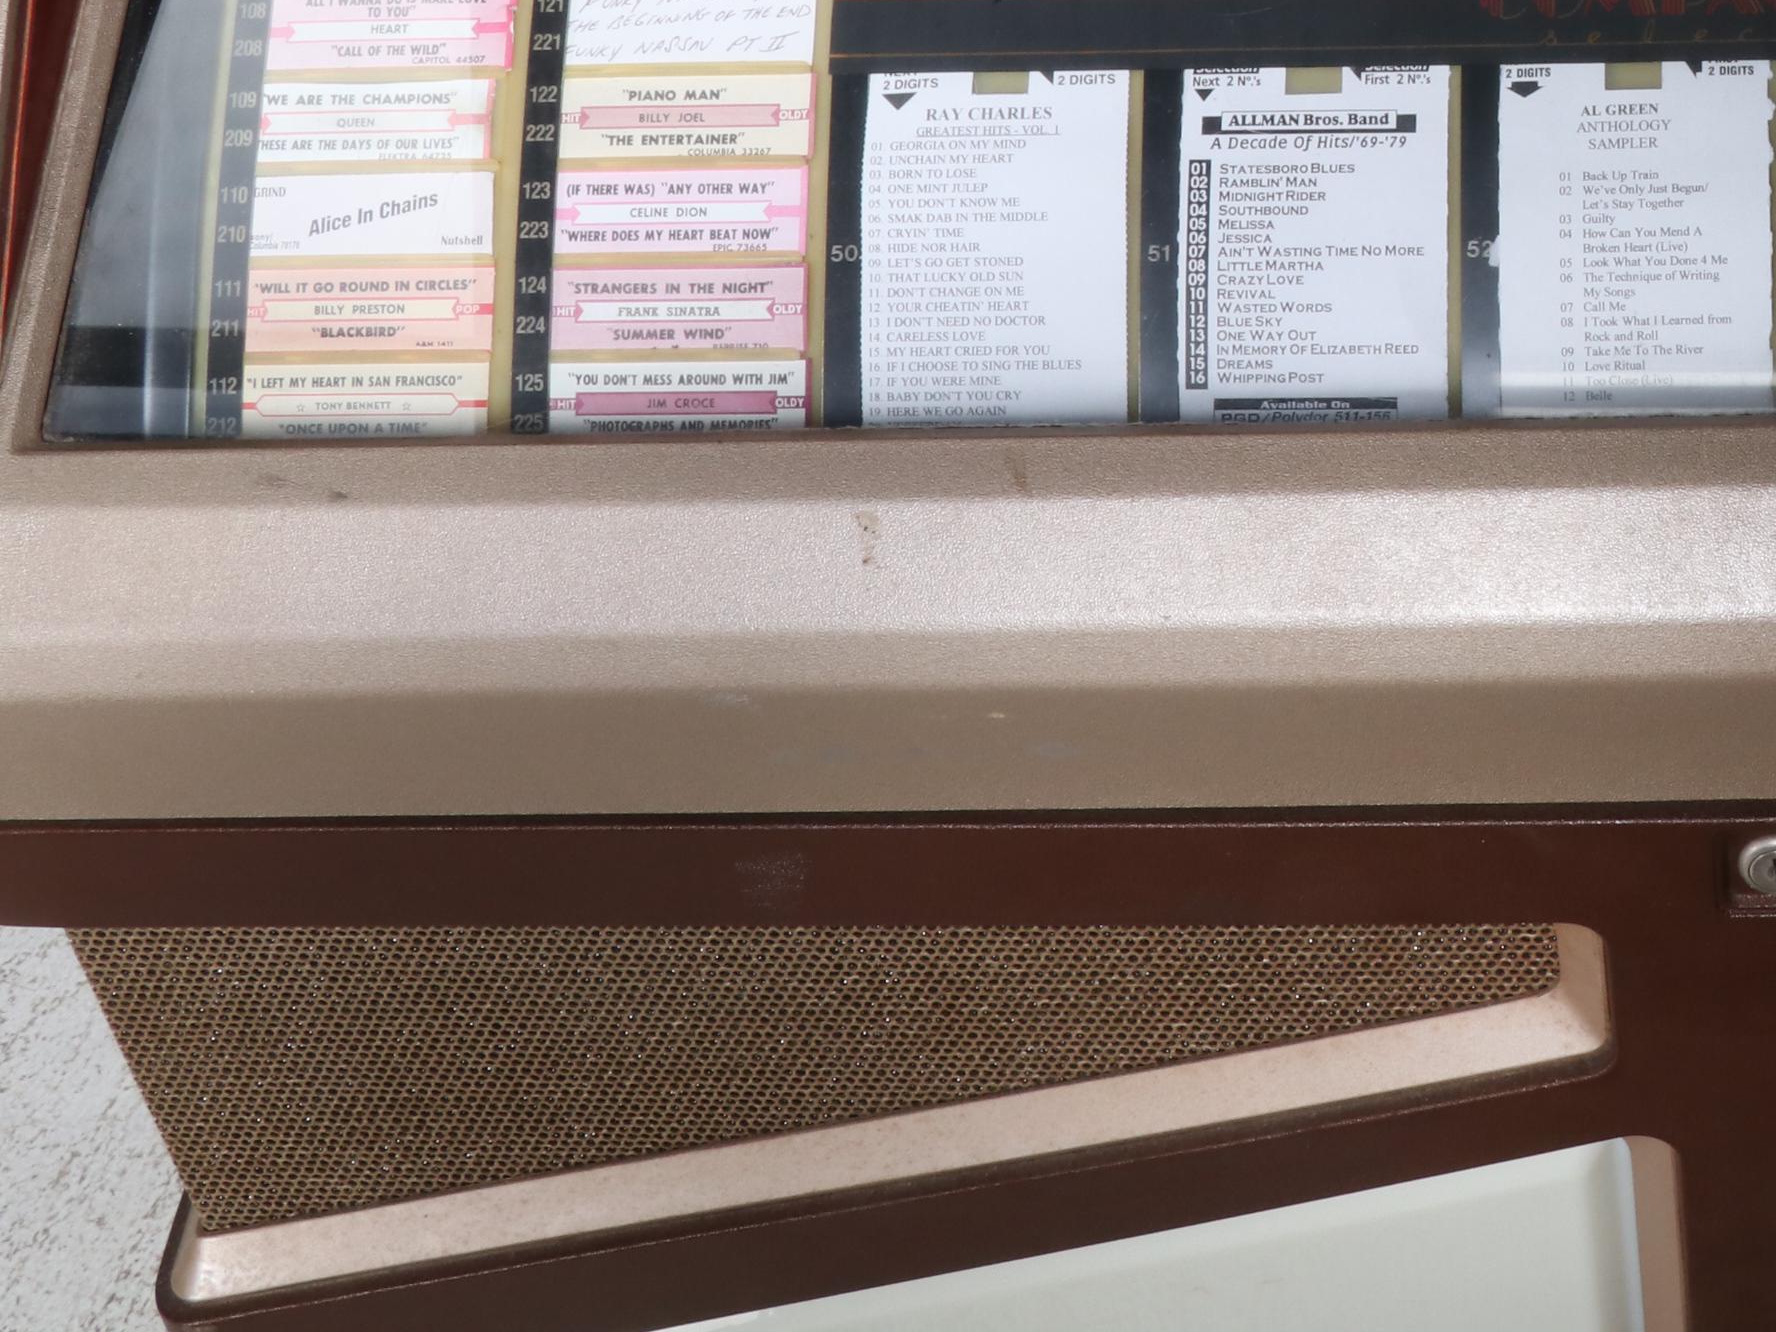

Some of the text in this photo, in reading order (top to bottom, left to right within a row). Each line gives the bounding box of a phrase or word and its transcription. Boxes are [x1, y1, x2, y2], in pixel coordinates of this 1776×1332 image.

[926, 106, 1052, 122] RAY CHARLES
[1580, 103, 1658, 117] AL GREEN
[638, 112, 706, 124] BILLY JOEL
[1228, 109, 1389, 127] ALLMAN Bros. Band
[1576, 119, 1672, 134] ANTHOLOGY
[1587, 136, 1659, 150] SAMPLER
[1219, 162, 1356, 175] STATESBORO BLUES
[522, 181, 551, 200] 123
[629, 206, 708, 218] CELINE DION
[1218, 204, 1309, 217] SOUTHBOUND
